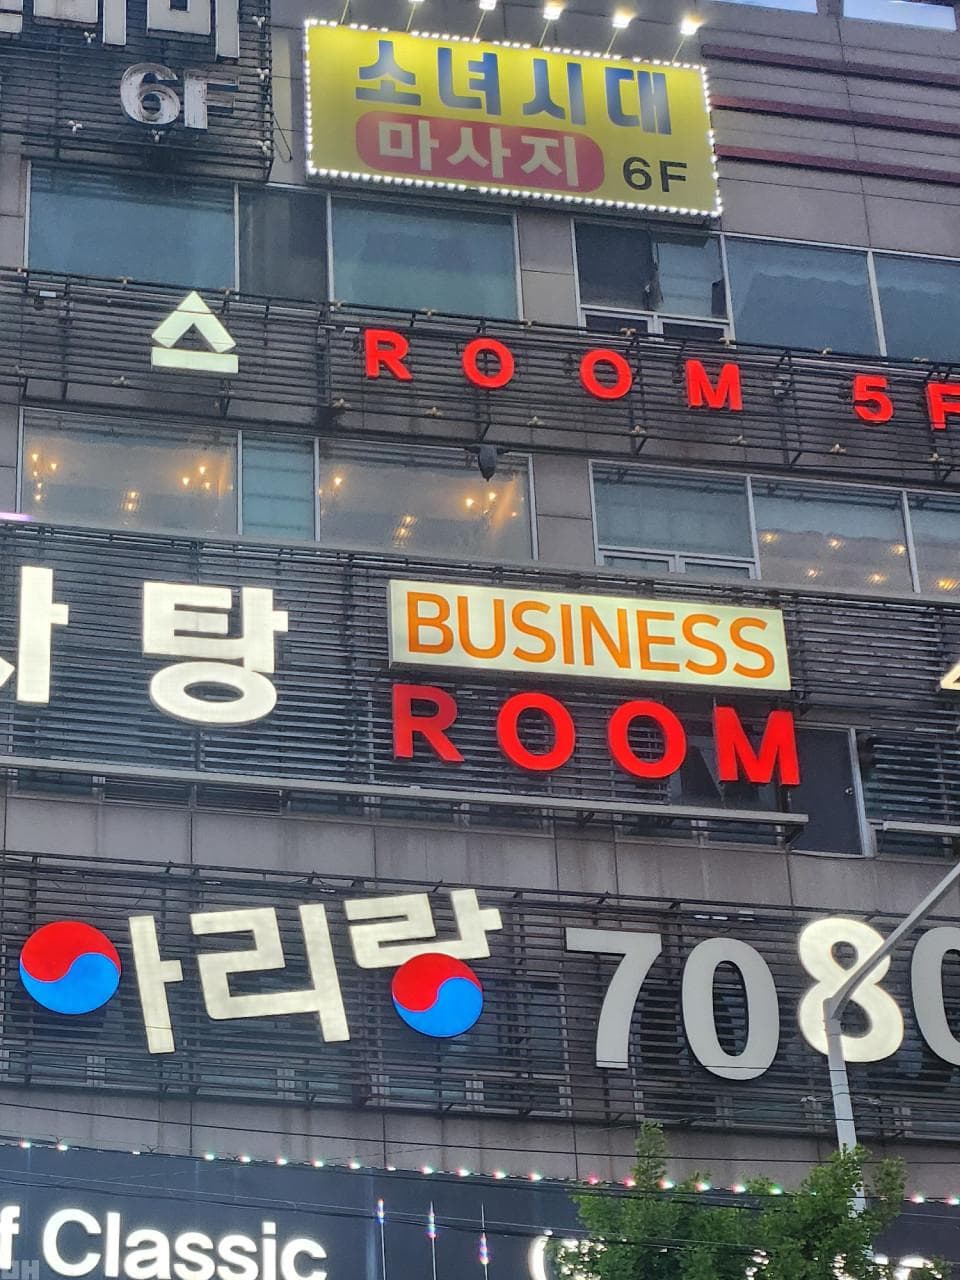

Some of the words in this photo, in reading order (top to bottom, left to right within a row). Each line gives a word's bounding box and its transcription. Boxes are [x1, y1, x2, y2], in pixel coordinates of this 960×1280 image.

[121, 62, 238, 130] 6F
[355, 39, 672, 136] 소녀시대
[378, 119, 580, 187] 마사지
[622, 156, 688, 193] 6F
[362, 328, 744, 411] ROOM
[405, 590, 777, 679] BUSINESS
[392, 683, 802, 788] ROOM
